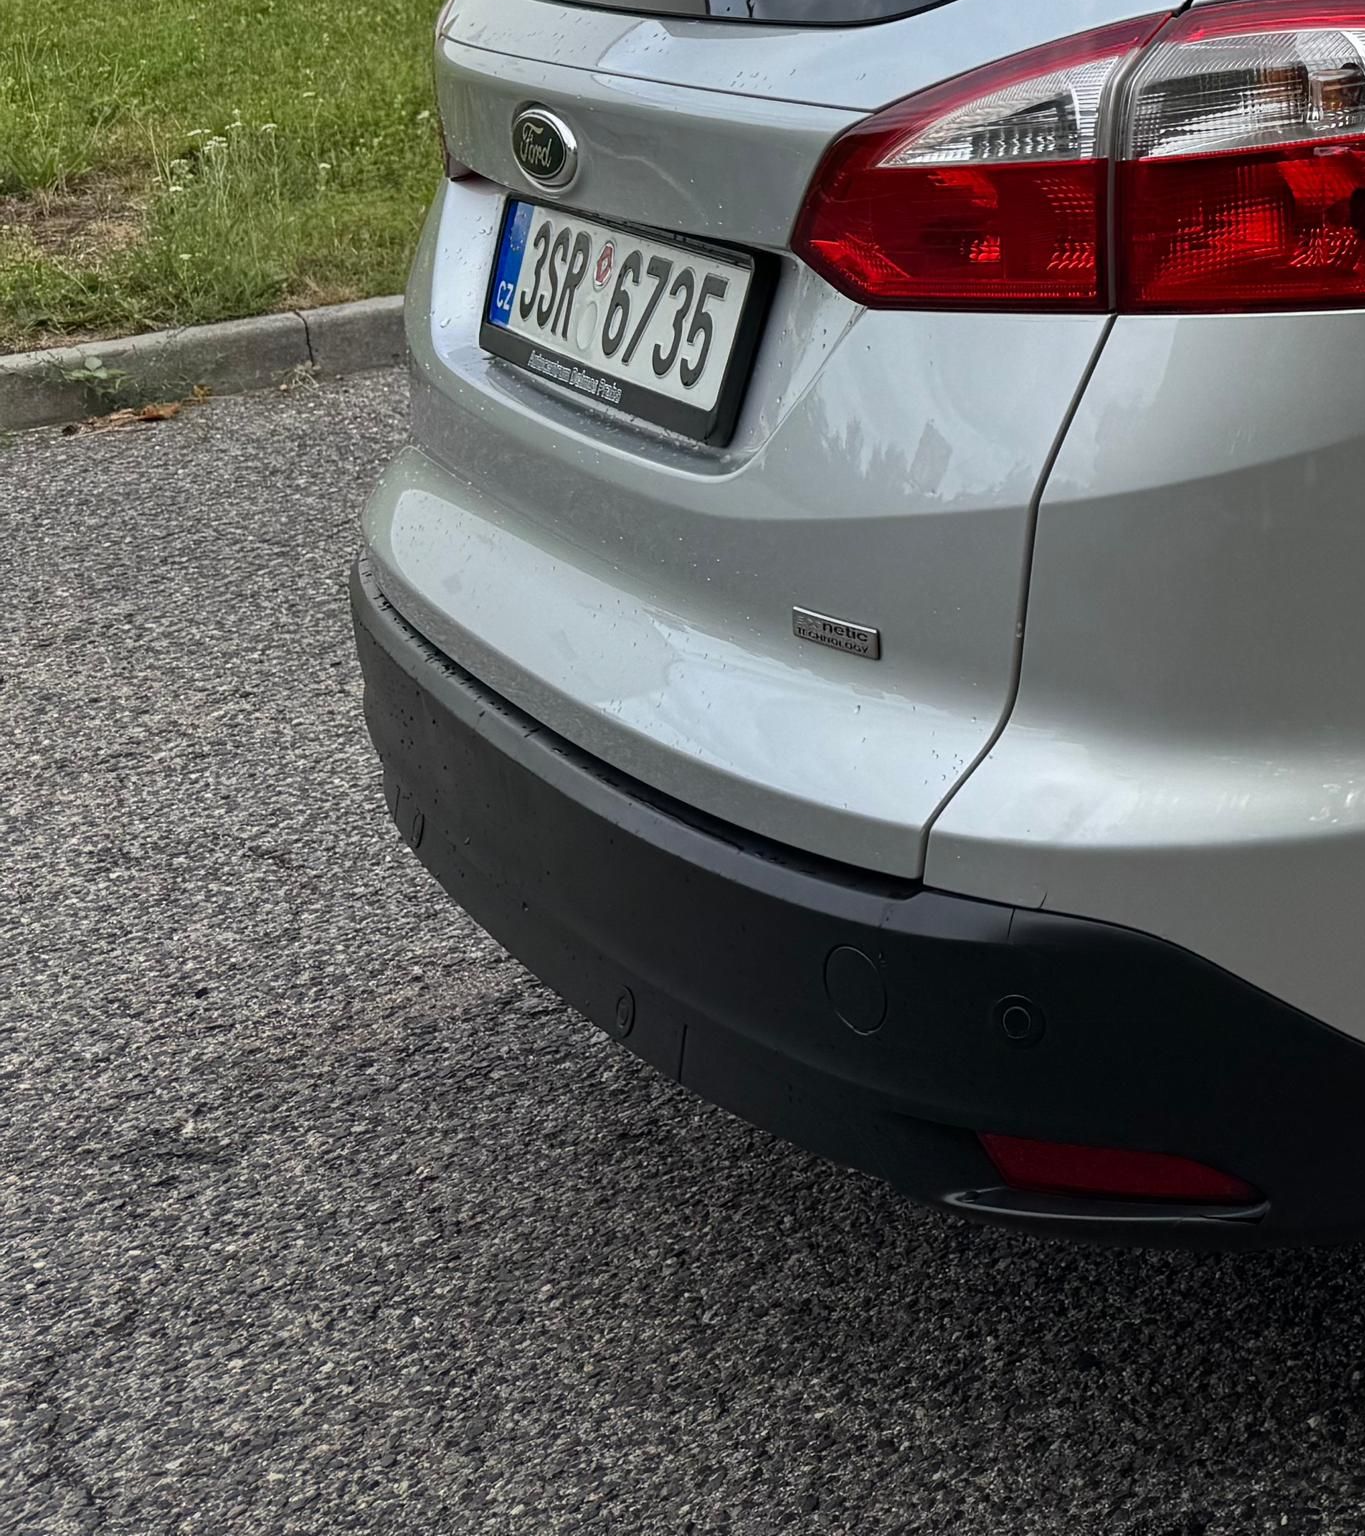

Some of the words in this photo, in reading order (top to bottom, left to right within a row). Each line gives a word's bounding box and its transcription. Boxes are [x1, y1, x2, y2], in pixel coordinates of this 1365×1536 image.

[520, 122, 552, 168] Ford
[496, 280, 513, 311] CZ
[519, 220, 593, 342] 3SR
[601, 249, 730, 390] 6735
[797, 626, 869, 654] TECHNOLOGY
